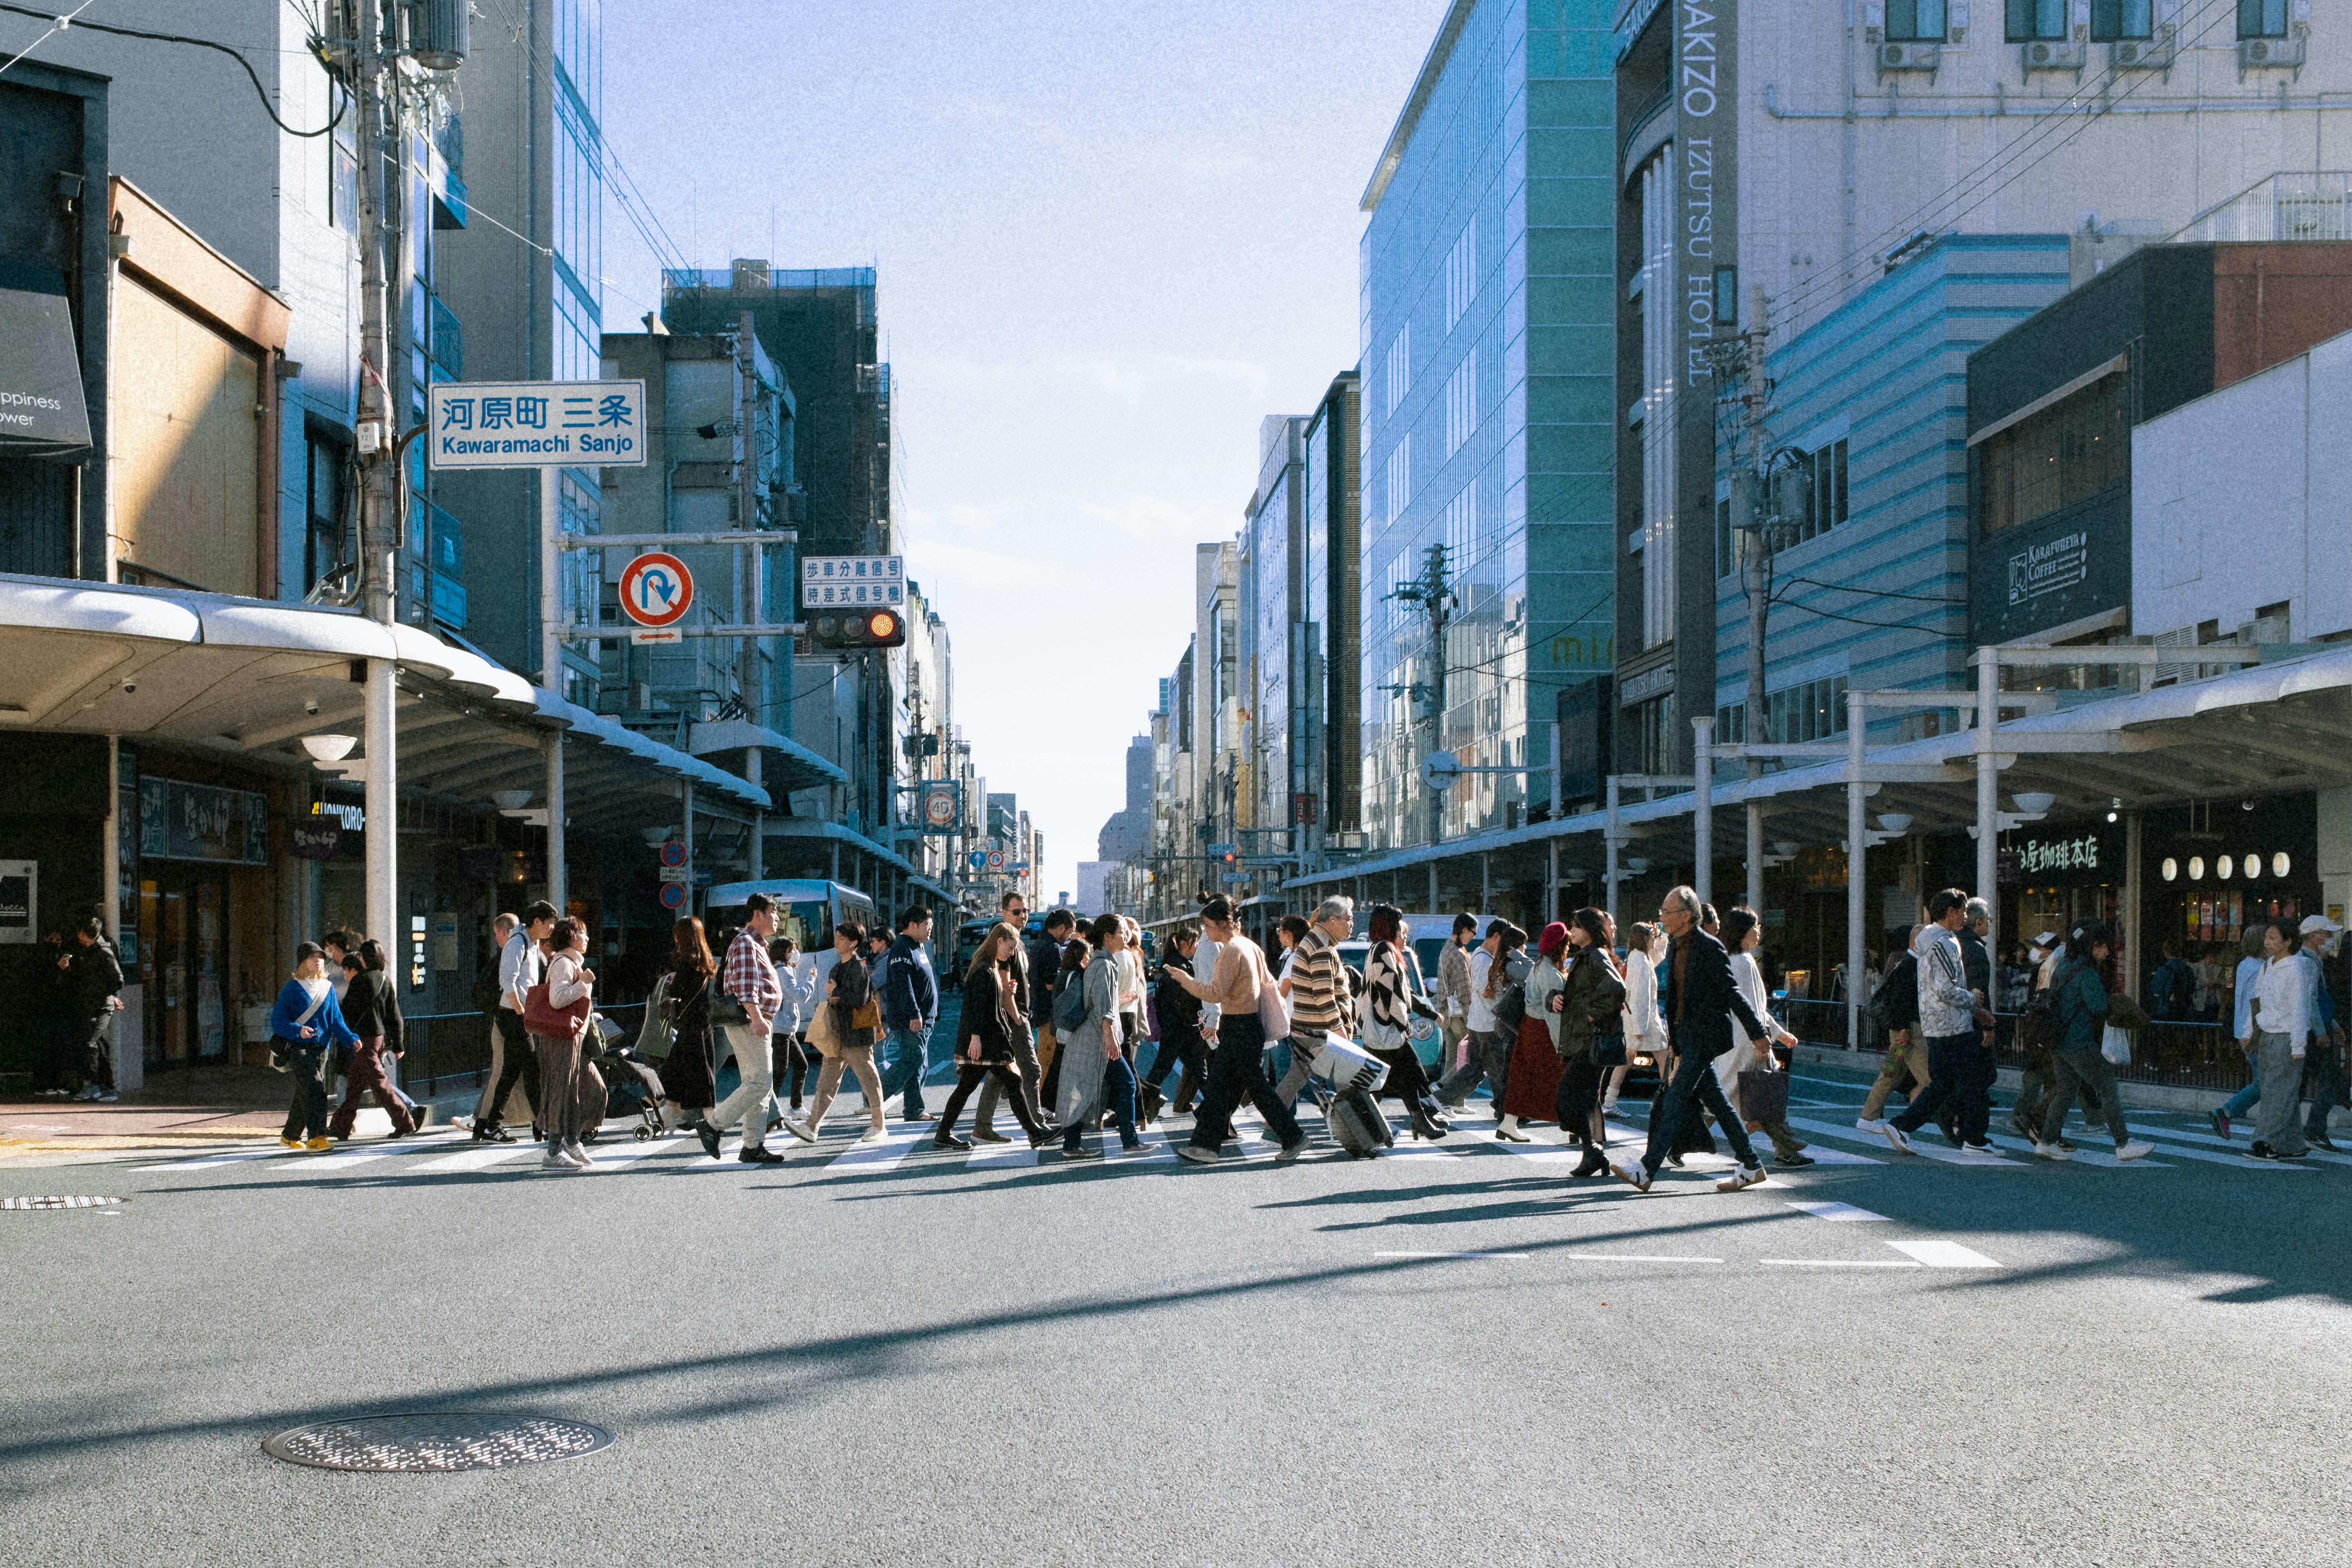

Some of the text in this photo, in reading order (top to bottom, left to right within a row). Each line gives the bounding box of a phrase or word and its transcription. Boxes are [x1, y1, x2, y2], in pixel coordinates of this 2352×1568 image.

[1683, 0, 1716, 388] AKIZO IZUTSU HOTEL
[442, 395, 633, 430] 河原町 三条
[443, 434, 633, 455] Kawaramachi Sanjo
[807, 560, 898, 578] 歩車分離信号
[2029, 560, 2057, 581] COFFEE
[808, 585, 899, 603] 時差式信号機
[932, 801, 948, 814] 40
[2001, 835, 2097, 873] 屋珈琲本店
